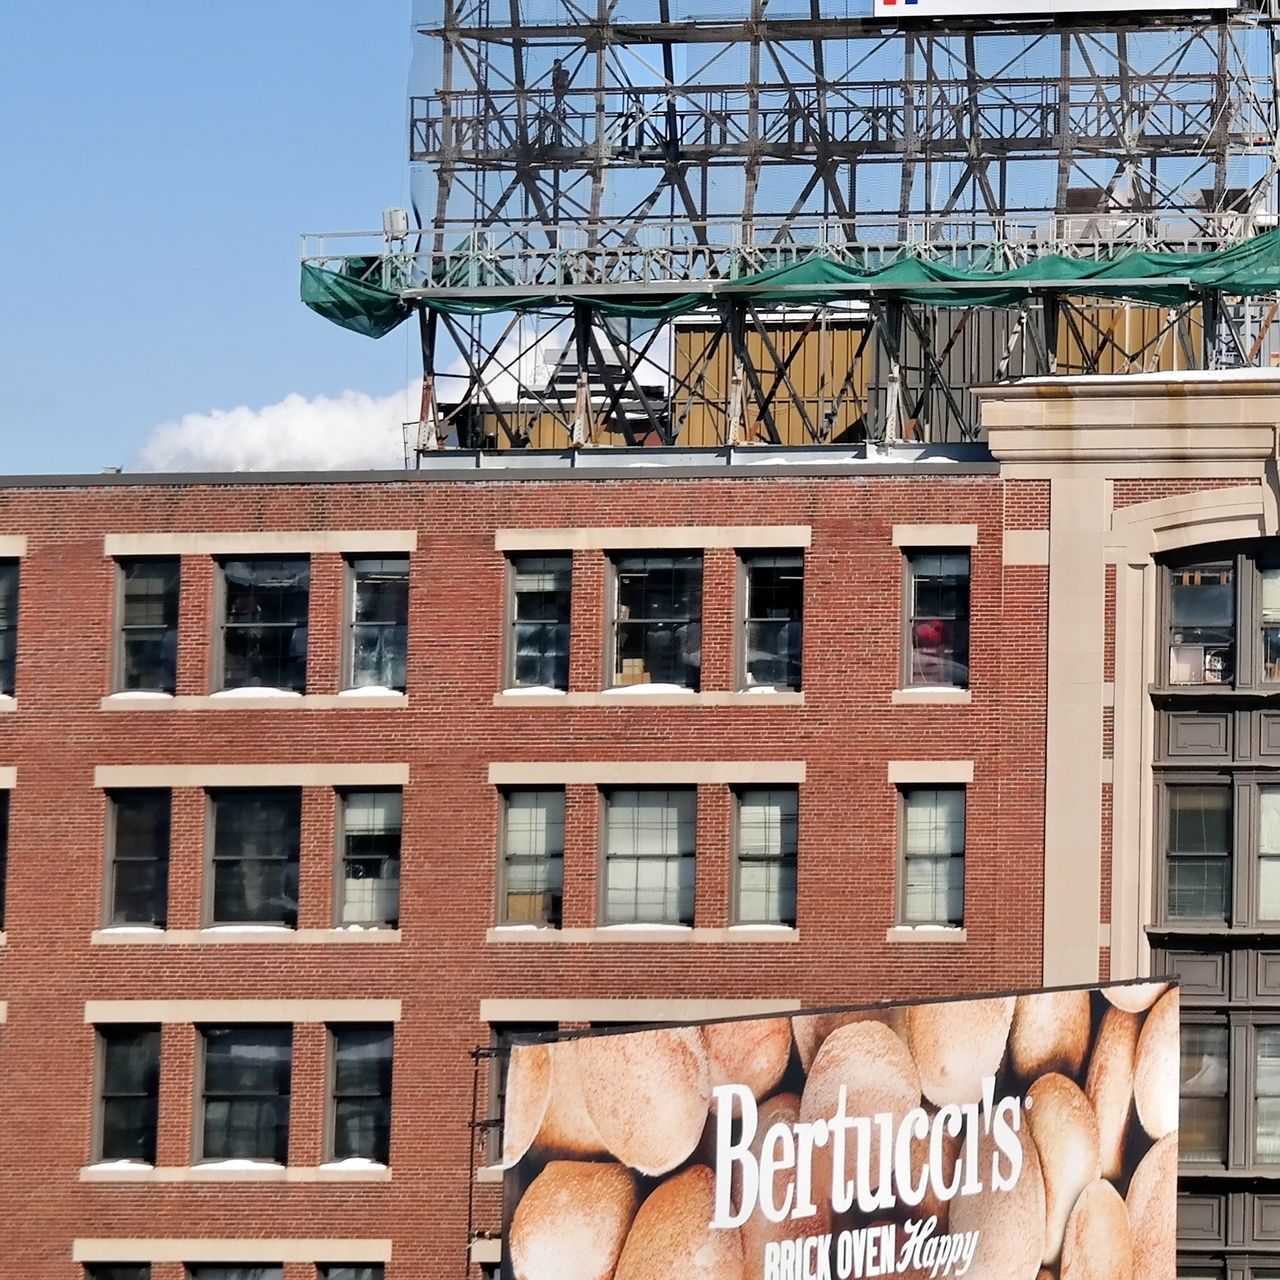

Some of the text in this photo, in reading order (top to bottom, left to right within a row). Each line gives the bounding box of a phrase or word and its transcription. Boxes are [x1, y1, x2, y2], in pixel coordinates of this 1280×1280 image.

[708, 1076, 1024, 1230] Bertucci's
[763, 1215, 980, 1280] BRICK OVEN Happy
